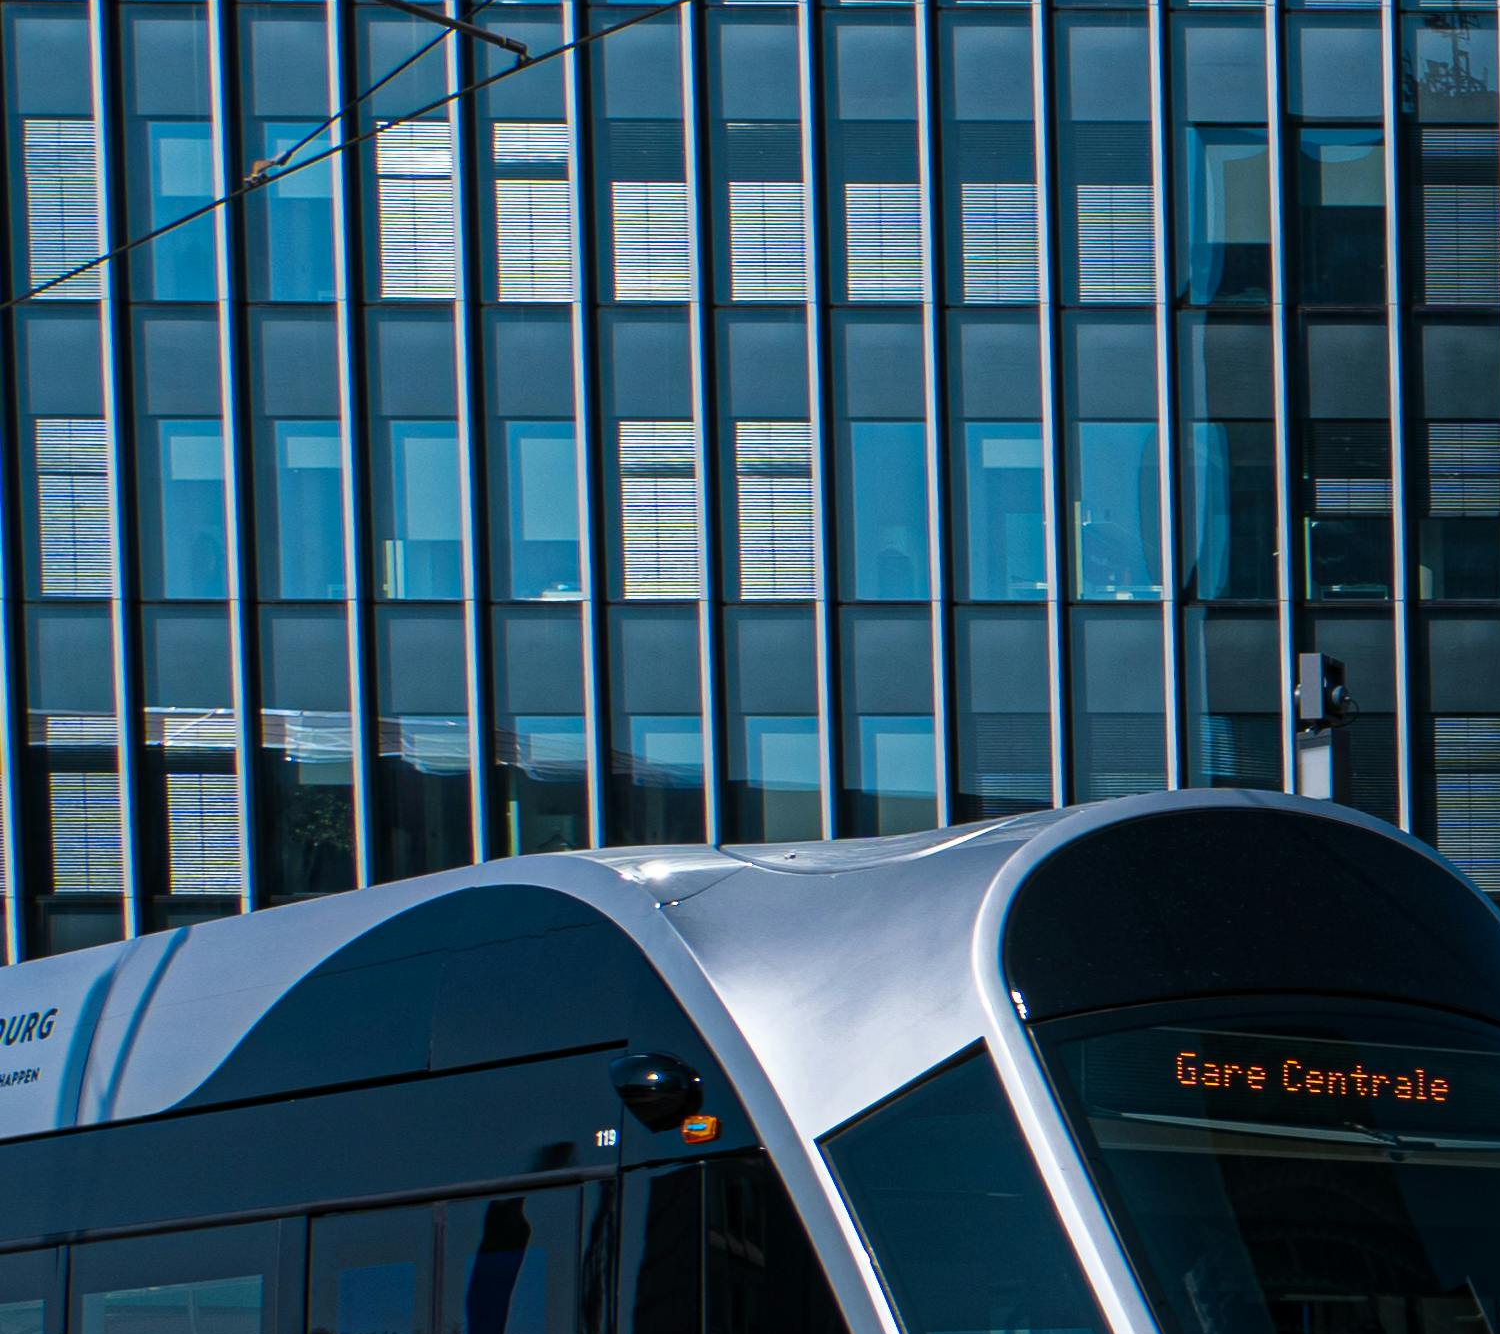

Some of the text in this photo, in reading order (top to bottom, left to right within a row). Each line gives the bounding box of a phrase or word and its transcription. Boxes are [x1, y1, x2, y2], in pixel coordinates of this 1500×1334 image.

[1177, 1052, 1449, 1101] Gare Centrale
[595, 1129, 617, 1147] 119
